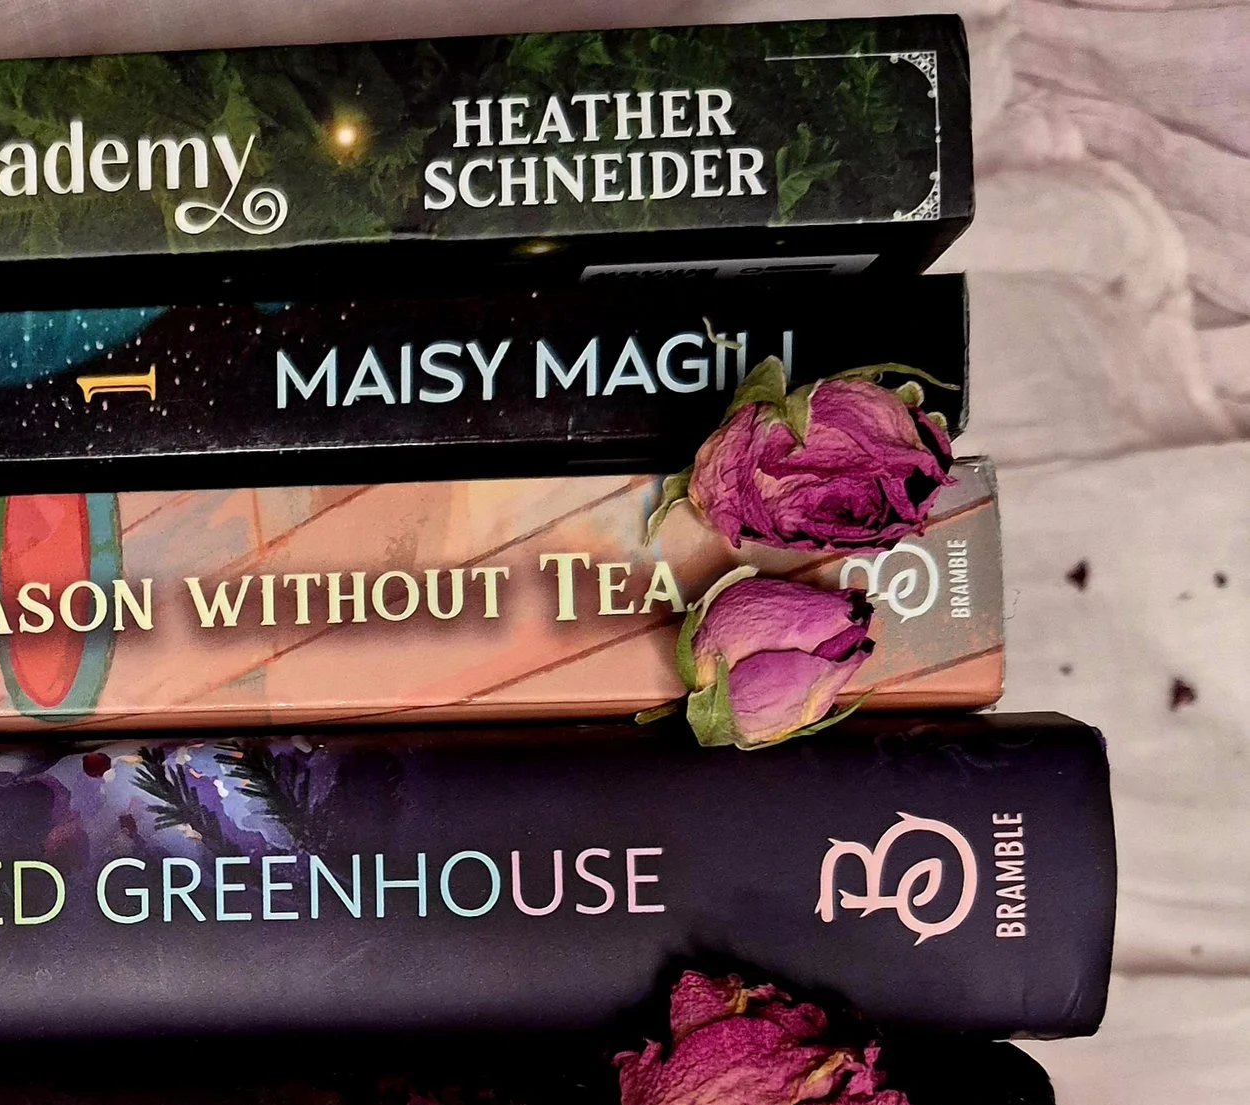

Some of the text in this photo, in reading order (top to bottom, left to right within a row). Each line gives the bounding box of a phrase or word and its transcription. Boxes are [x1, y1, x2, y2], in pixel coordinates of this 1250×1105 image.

[452, 88, 736, 148] HEATHER
[423, 148, 768, 211] SCHNEIDER
[75, 364, 157, 403] 1
[276, 338, 512, 409] MAISY
[184, 564, 511, 628] WITHOUT
[540, 551, 686, 622] TEA
[946, 539, 972, 619] BRAMBLE
[96, 847, 666, 924] GREENHOUSE
[992, 811, 1027, 939] BRAMBLE
